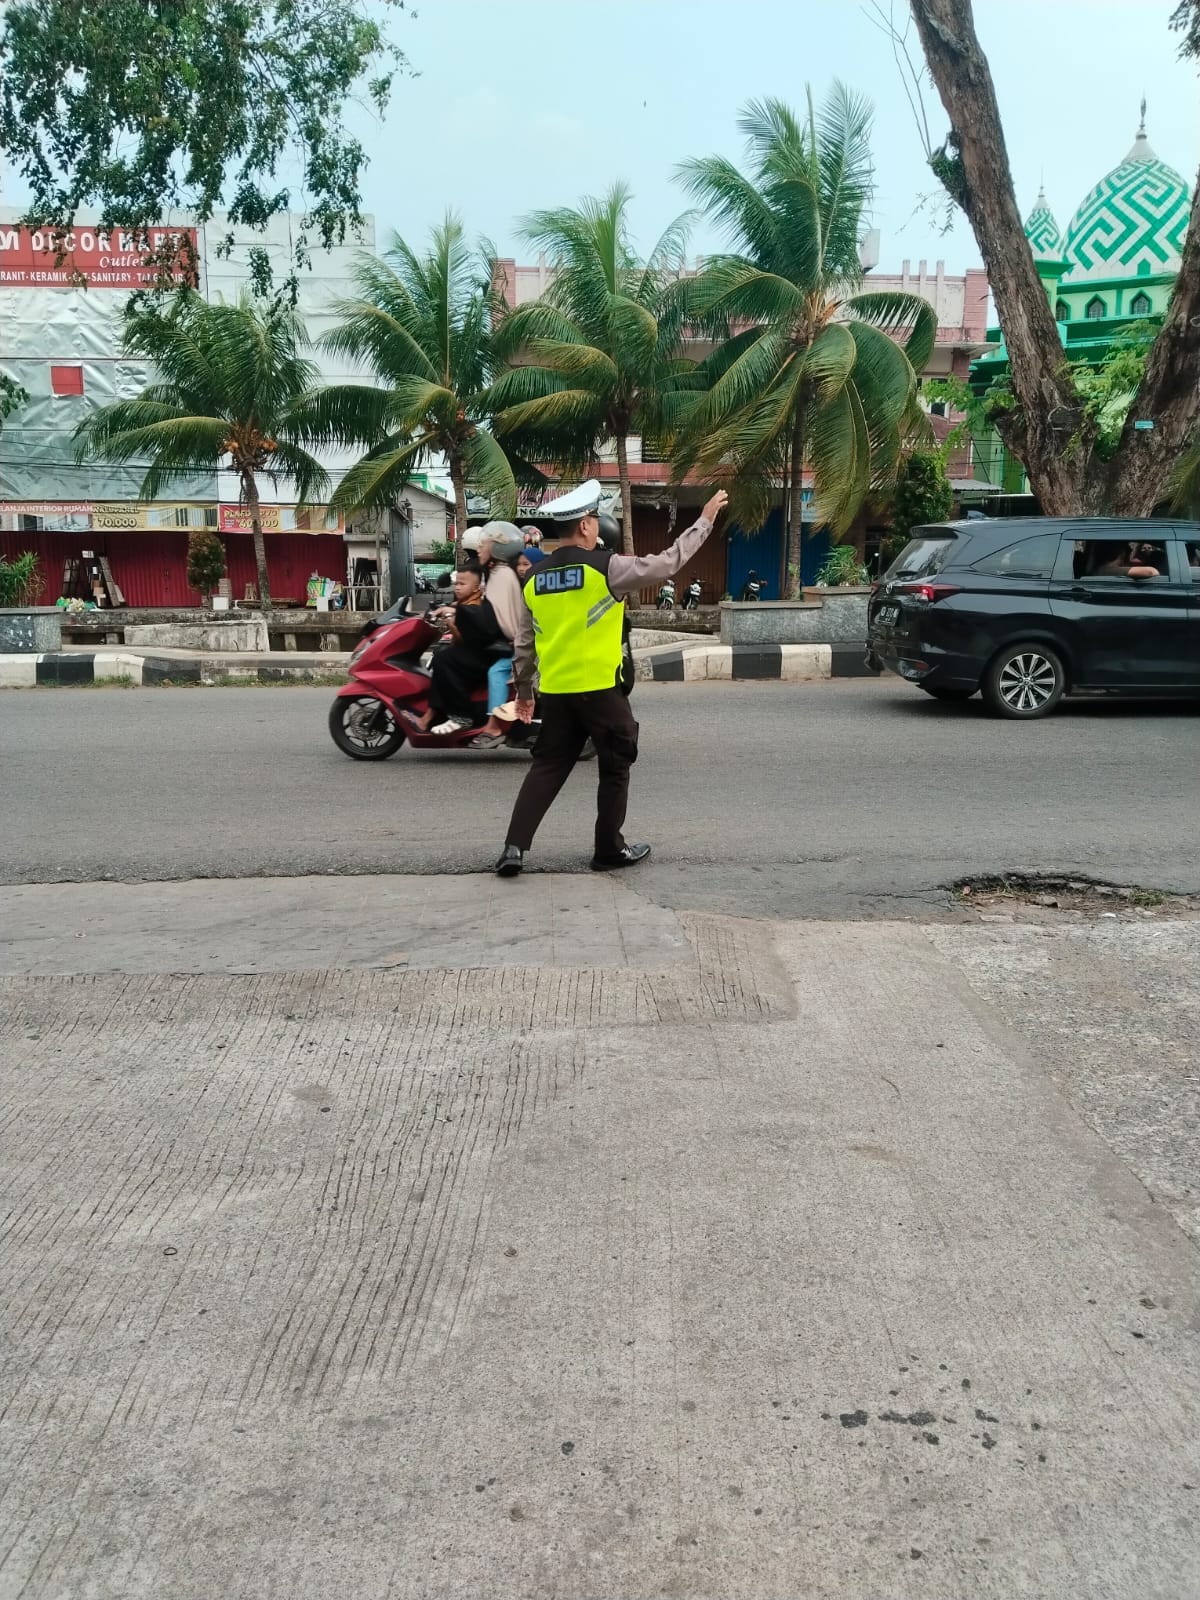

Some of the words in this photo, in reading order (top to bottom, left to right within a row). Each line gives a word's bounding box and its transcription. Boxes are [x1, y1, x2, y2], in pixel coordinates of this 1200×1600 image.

[30, 271, 68, 282] KERAMIK
[91, 272, 131, 283] SANITARY
[64, 504, 93, 513] RUMAH
[98, 517, 137, 529] 70.000
[536, 568, 582, 592] POLSI
